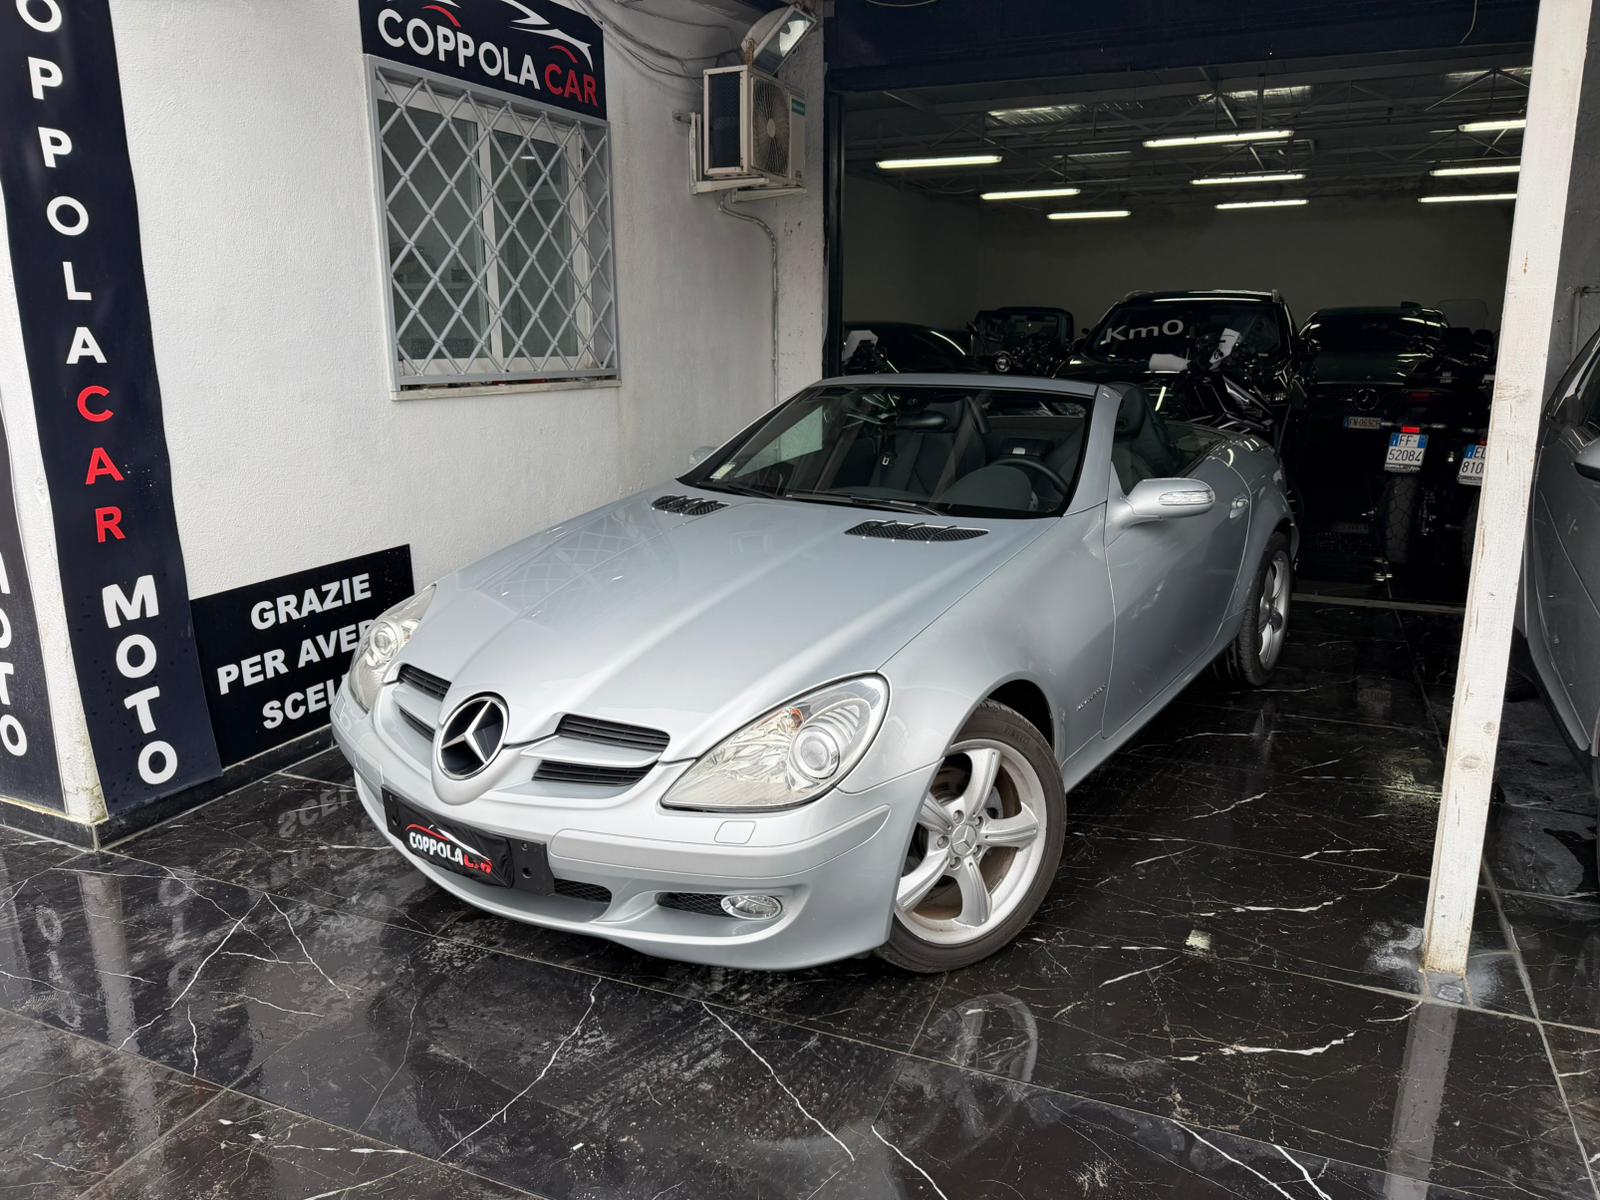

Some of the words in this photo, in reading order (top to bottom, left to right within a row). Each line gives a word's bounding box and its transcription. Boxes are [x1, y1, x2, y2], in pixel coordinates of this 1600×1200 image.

[1388, 449, 1424, 462] 52084
[75, 385, 126, 543] CAR
[102, 574, 178, 785] MOTO
[250, 572, 372, 630] GRAZIE
[216, 648, 289, 695] PER
[409, 831, 464, 866] COPPOLA
